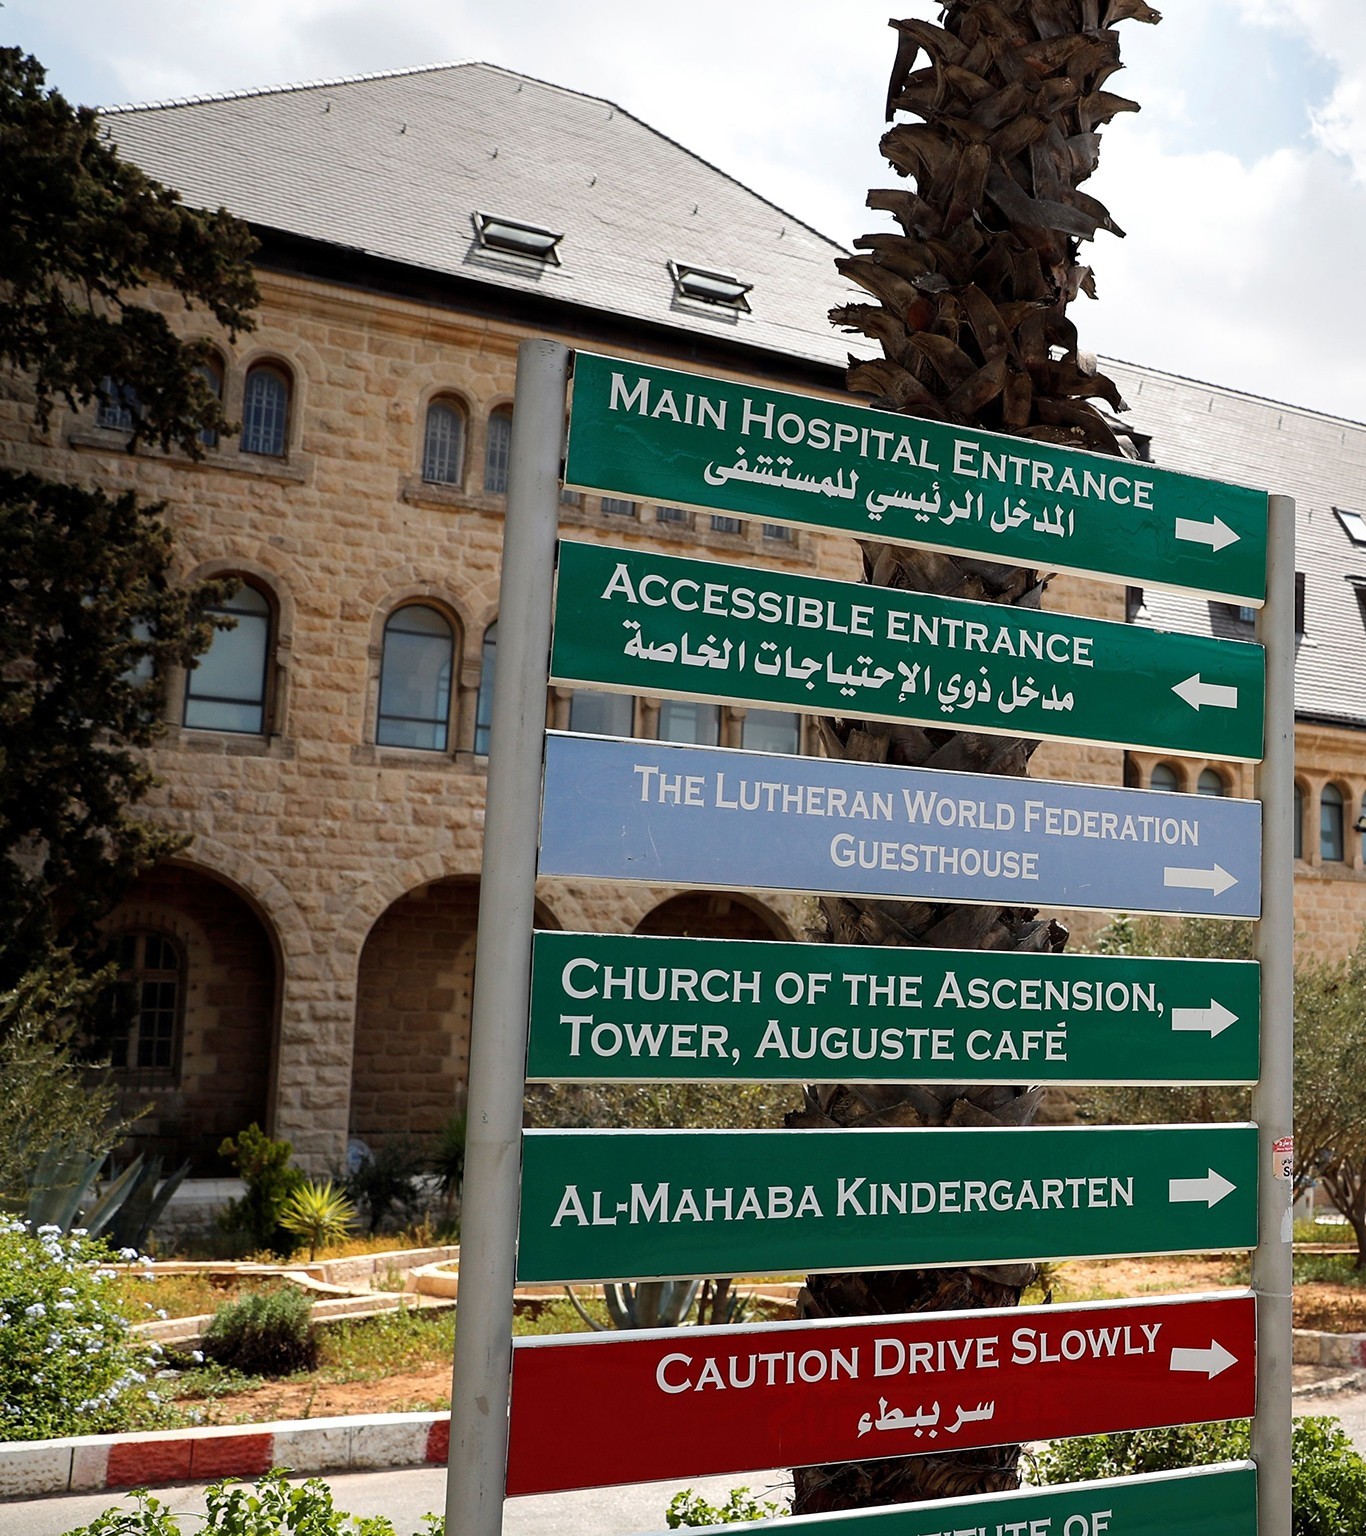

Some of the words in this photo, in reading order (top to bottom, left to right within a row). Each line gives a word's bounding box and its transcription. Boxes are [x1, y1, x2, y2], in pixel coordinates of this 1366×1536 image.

[609, 373, 727, 430] MAIN
[741, 399, 939, 472] HOSPITAL
[953, 440, 1153, 510] ENTRANCE
[866, 481, 983, 525] الرئيسي
[991, 497, 1074, 537] المدخل
[601, 563, 874, 637] ACCESSIBLE
[887, 610, 1093, 667] ENTRANCE
[623, 620, 746, 672] الخاصة
[937, 667, 991, 714] ذوي
[998, 676, 1075, 713] مدخل
[634, 765, 704, 806] THE
[715, 773, 892, 820] LUTHERAN
[903, 790, 1015, 831] WORLD
[1024, 801, 1198, 846] FEDERATION
[830, 833, 1038, 880] GUESTHOUSE
[561, 958, 761, 1002] CHURCH
[776, 972, 831, 1004] OF
[843, 973, 922, 1008] THE
[934, 972, 1163, 1017] ASCENSION,
[560, 1015, 740, 1065] TOWER,
[754, 1020, 954, 1060] AUGUSTE
[967, 1022, 1067, 1061] CAFÉ
[551, 1183, 823, 1226] AL-MAHABA
[836, 1177, 1133, 1216] KINDERGARTEN
[657, 1348, 858, 1393] CAUTION
[874, 1336, 1000, 1376] DRIVE
[1012, 1324, 1163, 1364] SLOWLY
[857, 1396, 940, 1438] ببطء
[944, 1400, 995, 1433] سر
[1063, 1509, 1113, 1536] OF
